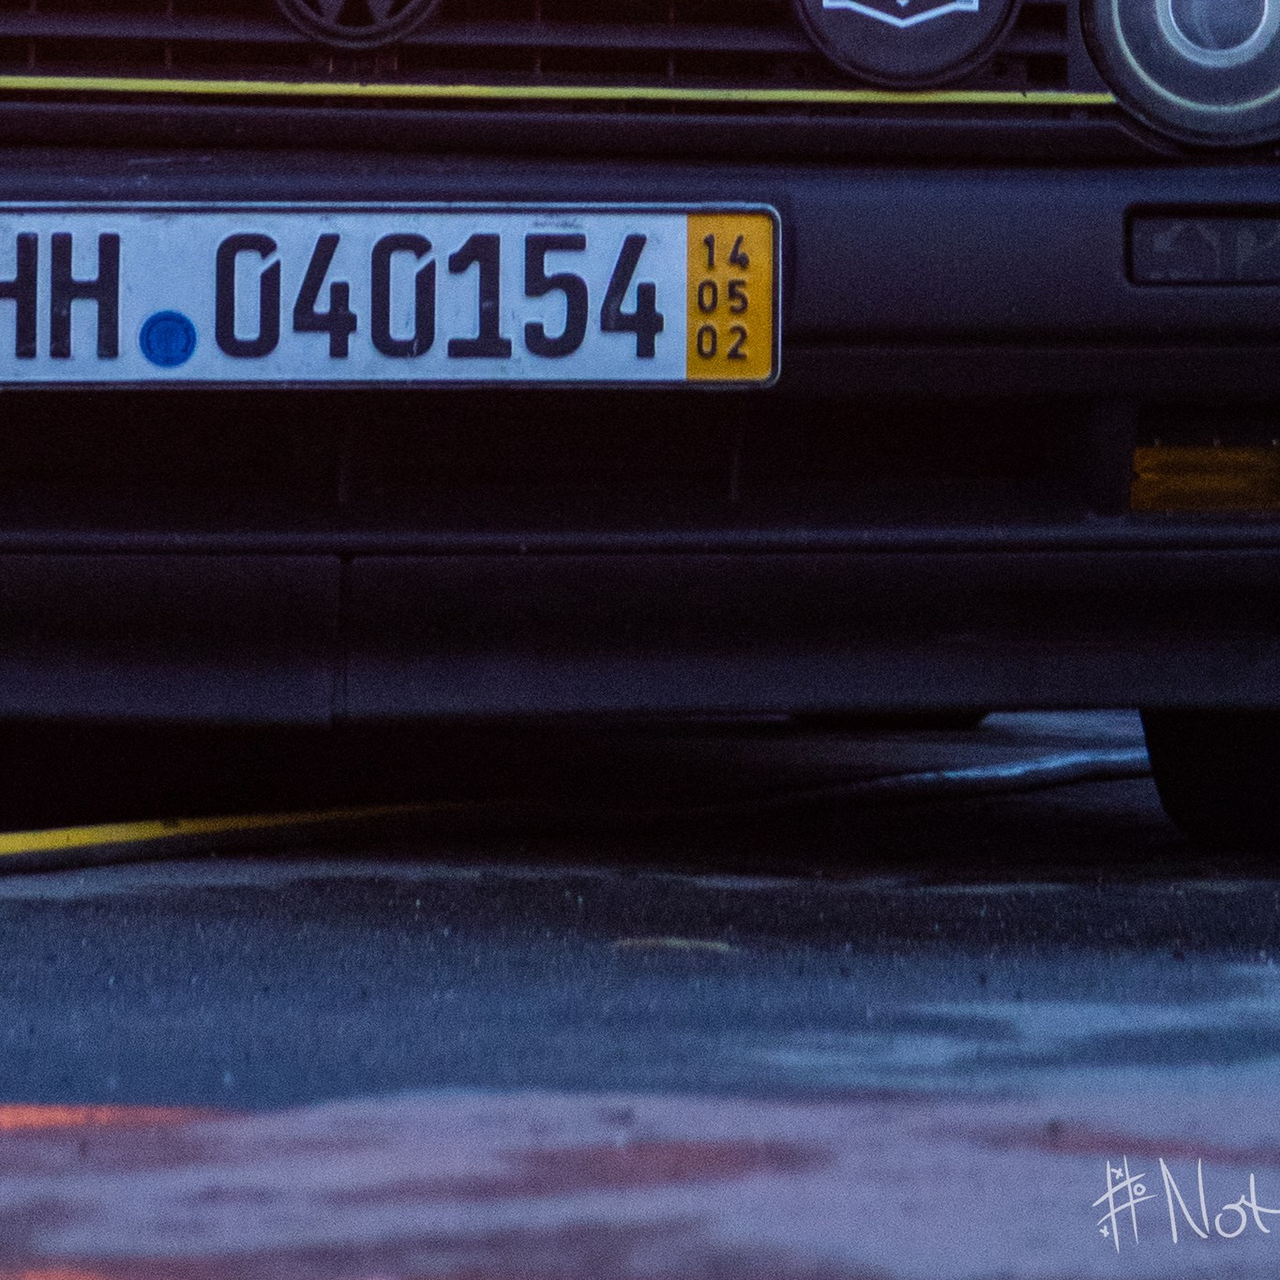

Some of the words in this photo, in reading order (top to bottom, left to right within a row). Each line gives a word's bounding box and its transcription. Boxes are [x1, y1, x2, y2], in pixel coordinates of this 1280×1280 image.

[703, 233, 750, 270] 14
[214, 232, 665, 360] 040154
[697, 278, 750, 316] 05
[696, 323, 749, 361] 02
